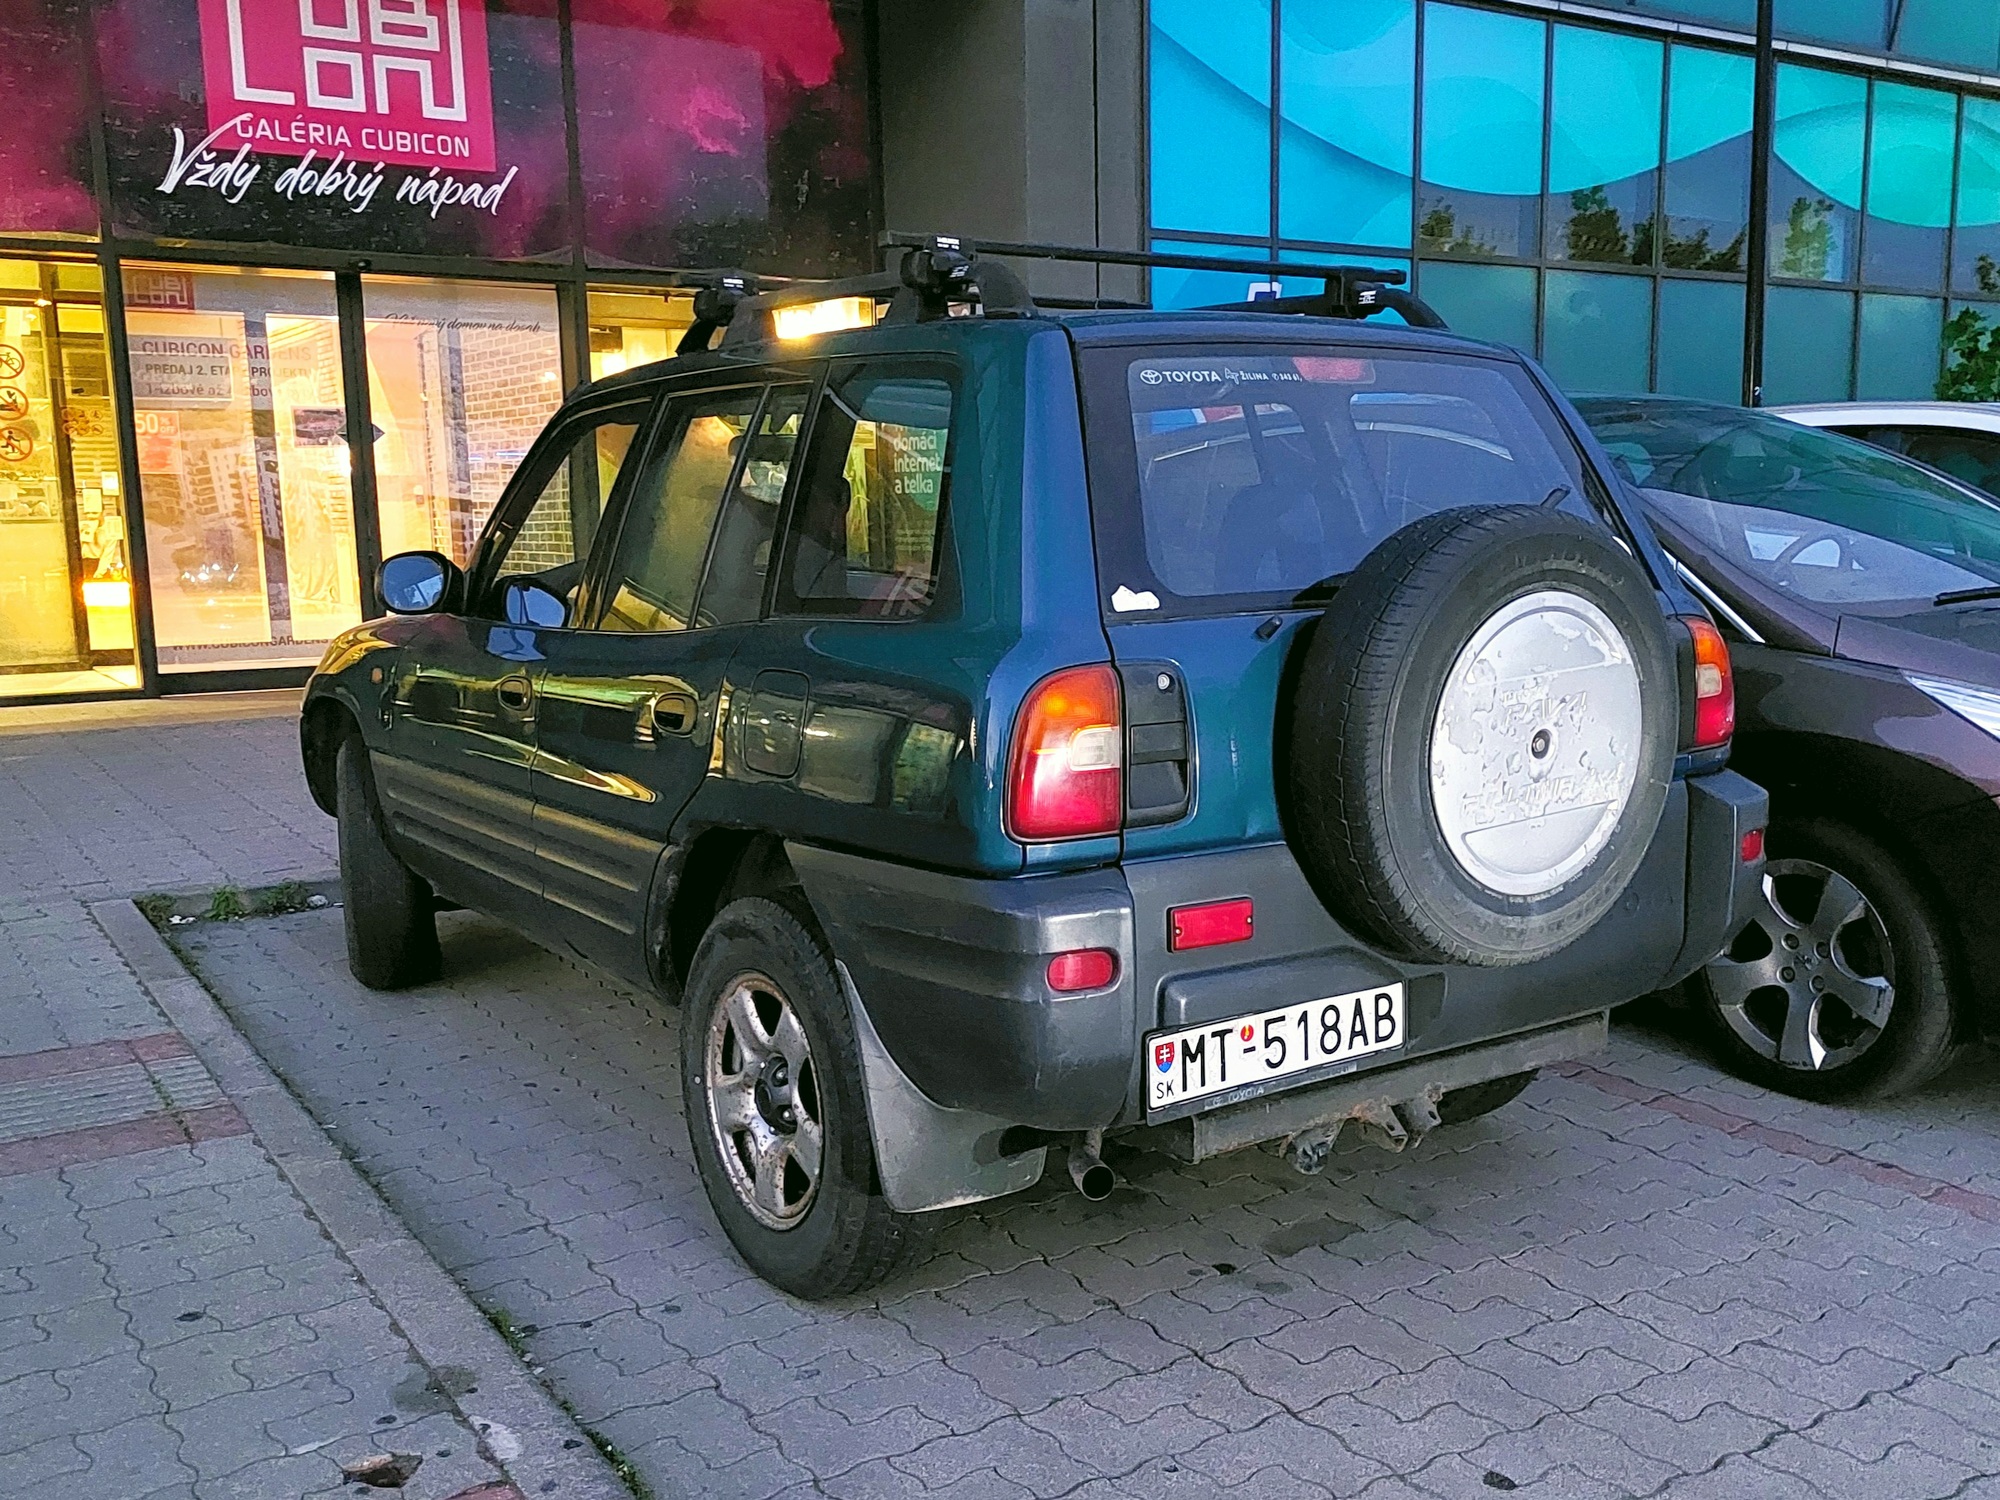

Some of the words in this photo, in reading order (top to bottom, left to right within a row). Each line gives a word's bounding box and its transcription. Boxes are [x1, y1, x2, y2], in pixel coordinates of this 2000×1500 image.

[236, 114, 352, 147] GALÉRIA
[361, 128, 470, 158] CUBICON
[155, 112, 262, 204] Vždy
[274, 148, 385, 214] dobrý
[396, 166, 519, 219] nápad
[142, 341, 223, 357] CUBICON
[145, 364, 193, 376] PREDAJ
[196, 365, 208, 376] 2.
[1162, 370, 1222, 382] TOYOTA
[1240, 370, 1270, 381] ŽILINA
[134, 413, 159, 434] 50
[893, 431, 937, 452] domáci
[894, 452, 942, 473] internet
[894, 479, 902, 494] a
[904, 473, 934, 494] telka
[1156, 1080, 1174, 1099] SK
